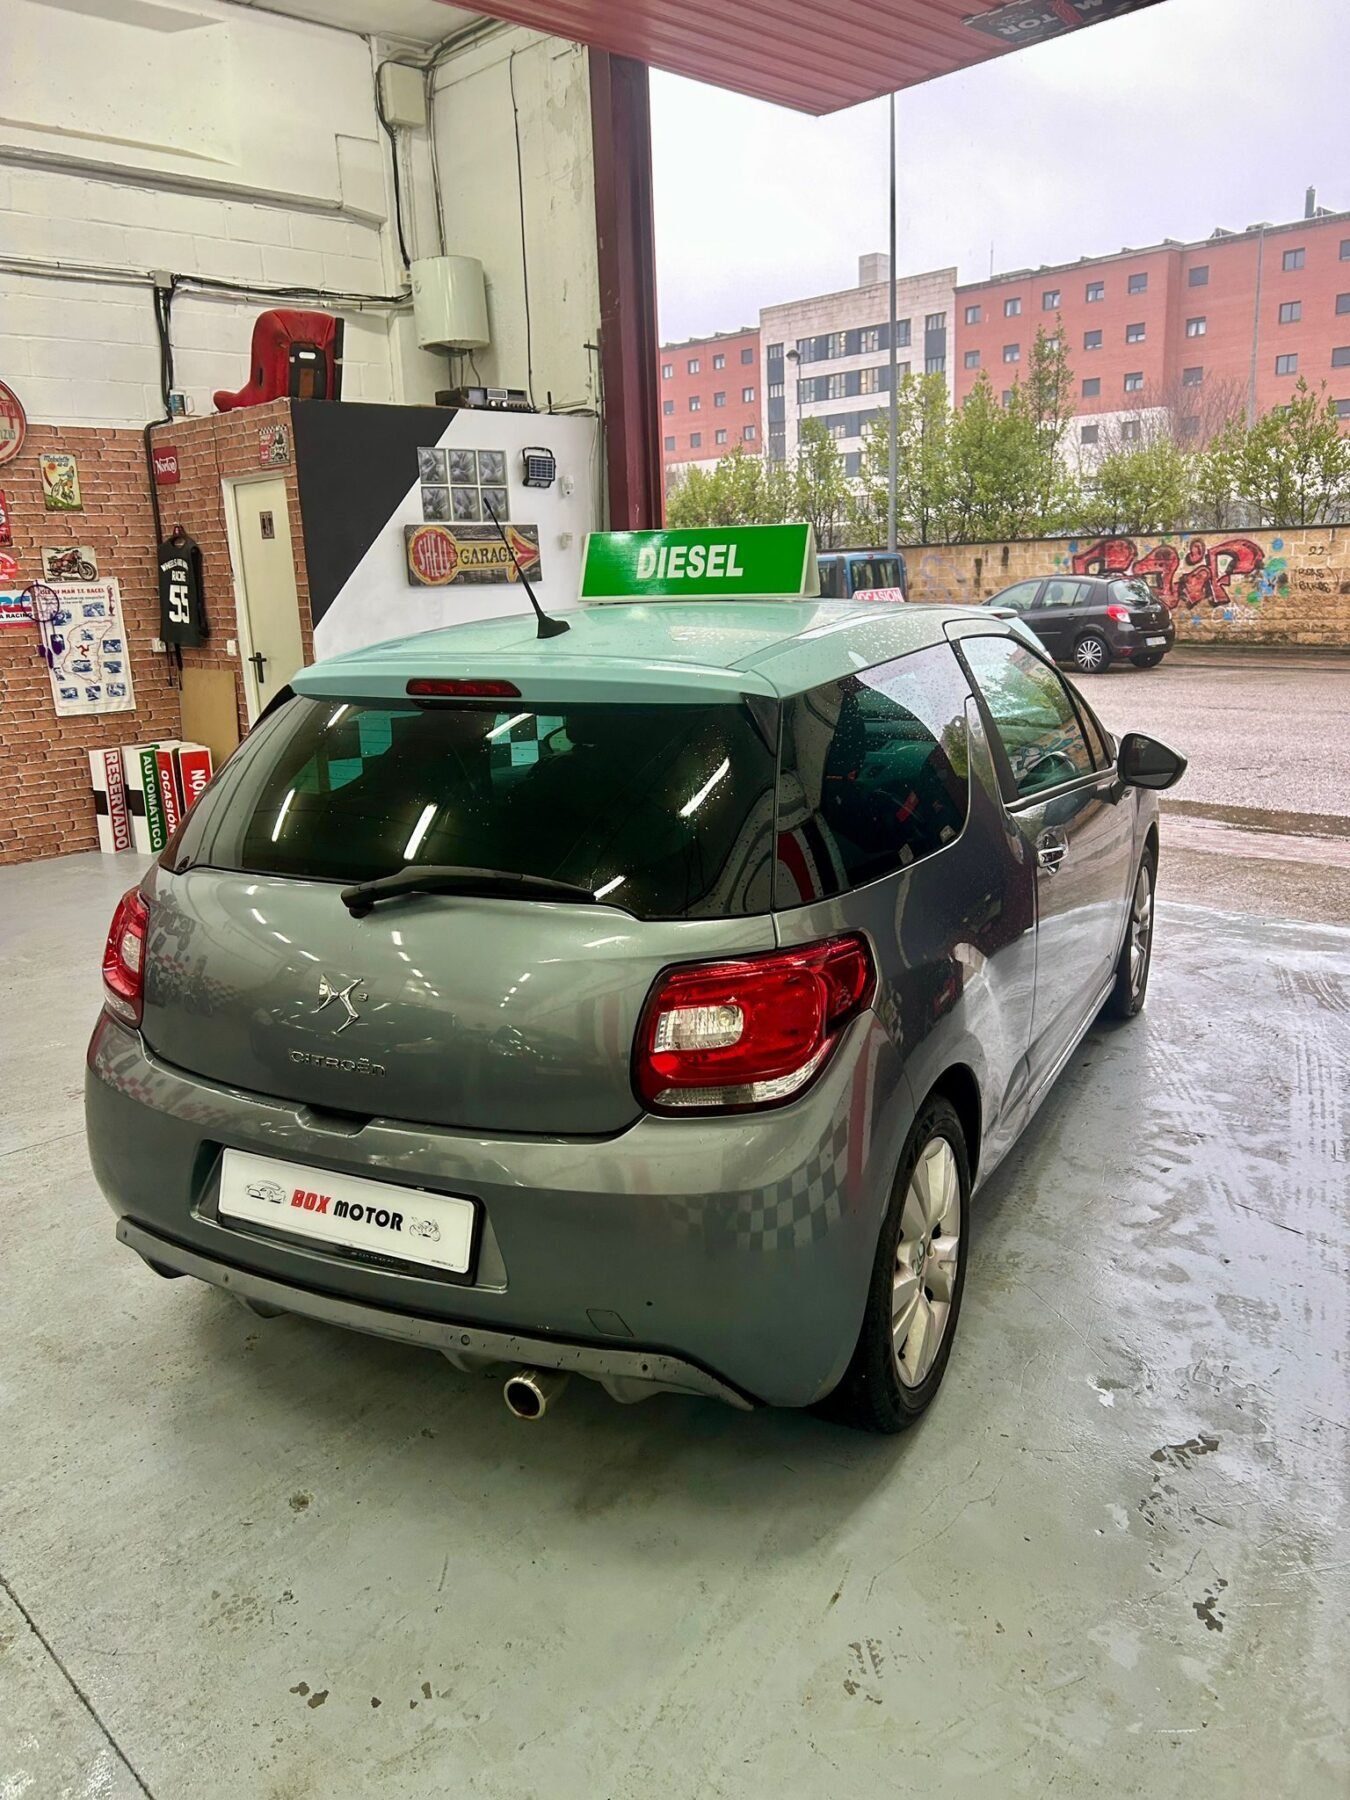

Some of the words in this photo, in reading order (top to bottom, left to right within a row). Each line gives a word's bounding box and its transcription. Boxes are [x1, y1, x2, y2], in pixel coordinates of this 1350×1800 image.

[154, 456, 177, 475] Norton
[418, 533, 450, 577] SHELL
[460, 546, 515, 565] GARAGE
[636, 544, 744, 579] DIESEL
[62, 587, 75, 595] MAN
[169, 584, 190, 624] 55
[105, 751, 129, 850] RESERVADO
[142, 755, 163, 849] AUTOMÁTICO
[160, 769, 179, 834] OCASIÓN
[290, 1050, 386, 1077] CITROËN
[290, 1189, 332, 1214] BOX
[333, 1200, 404, 1232] MOTOR
